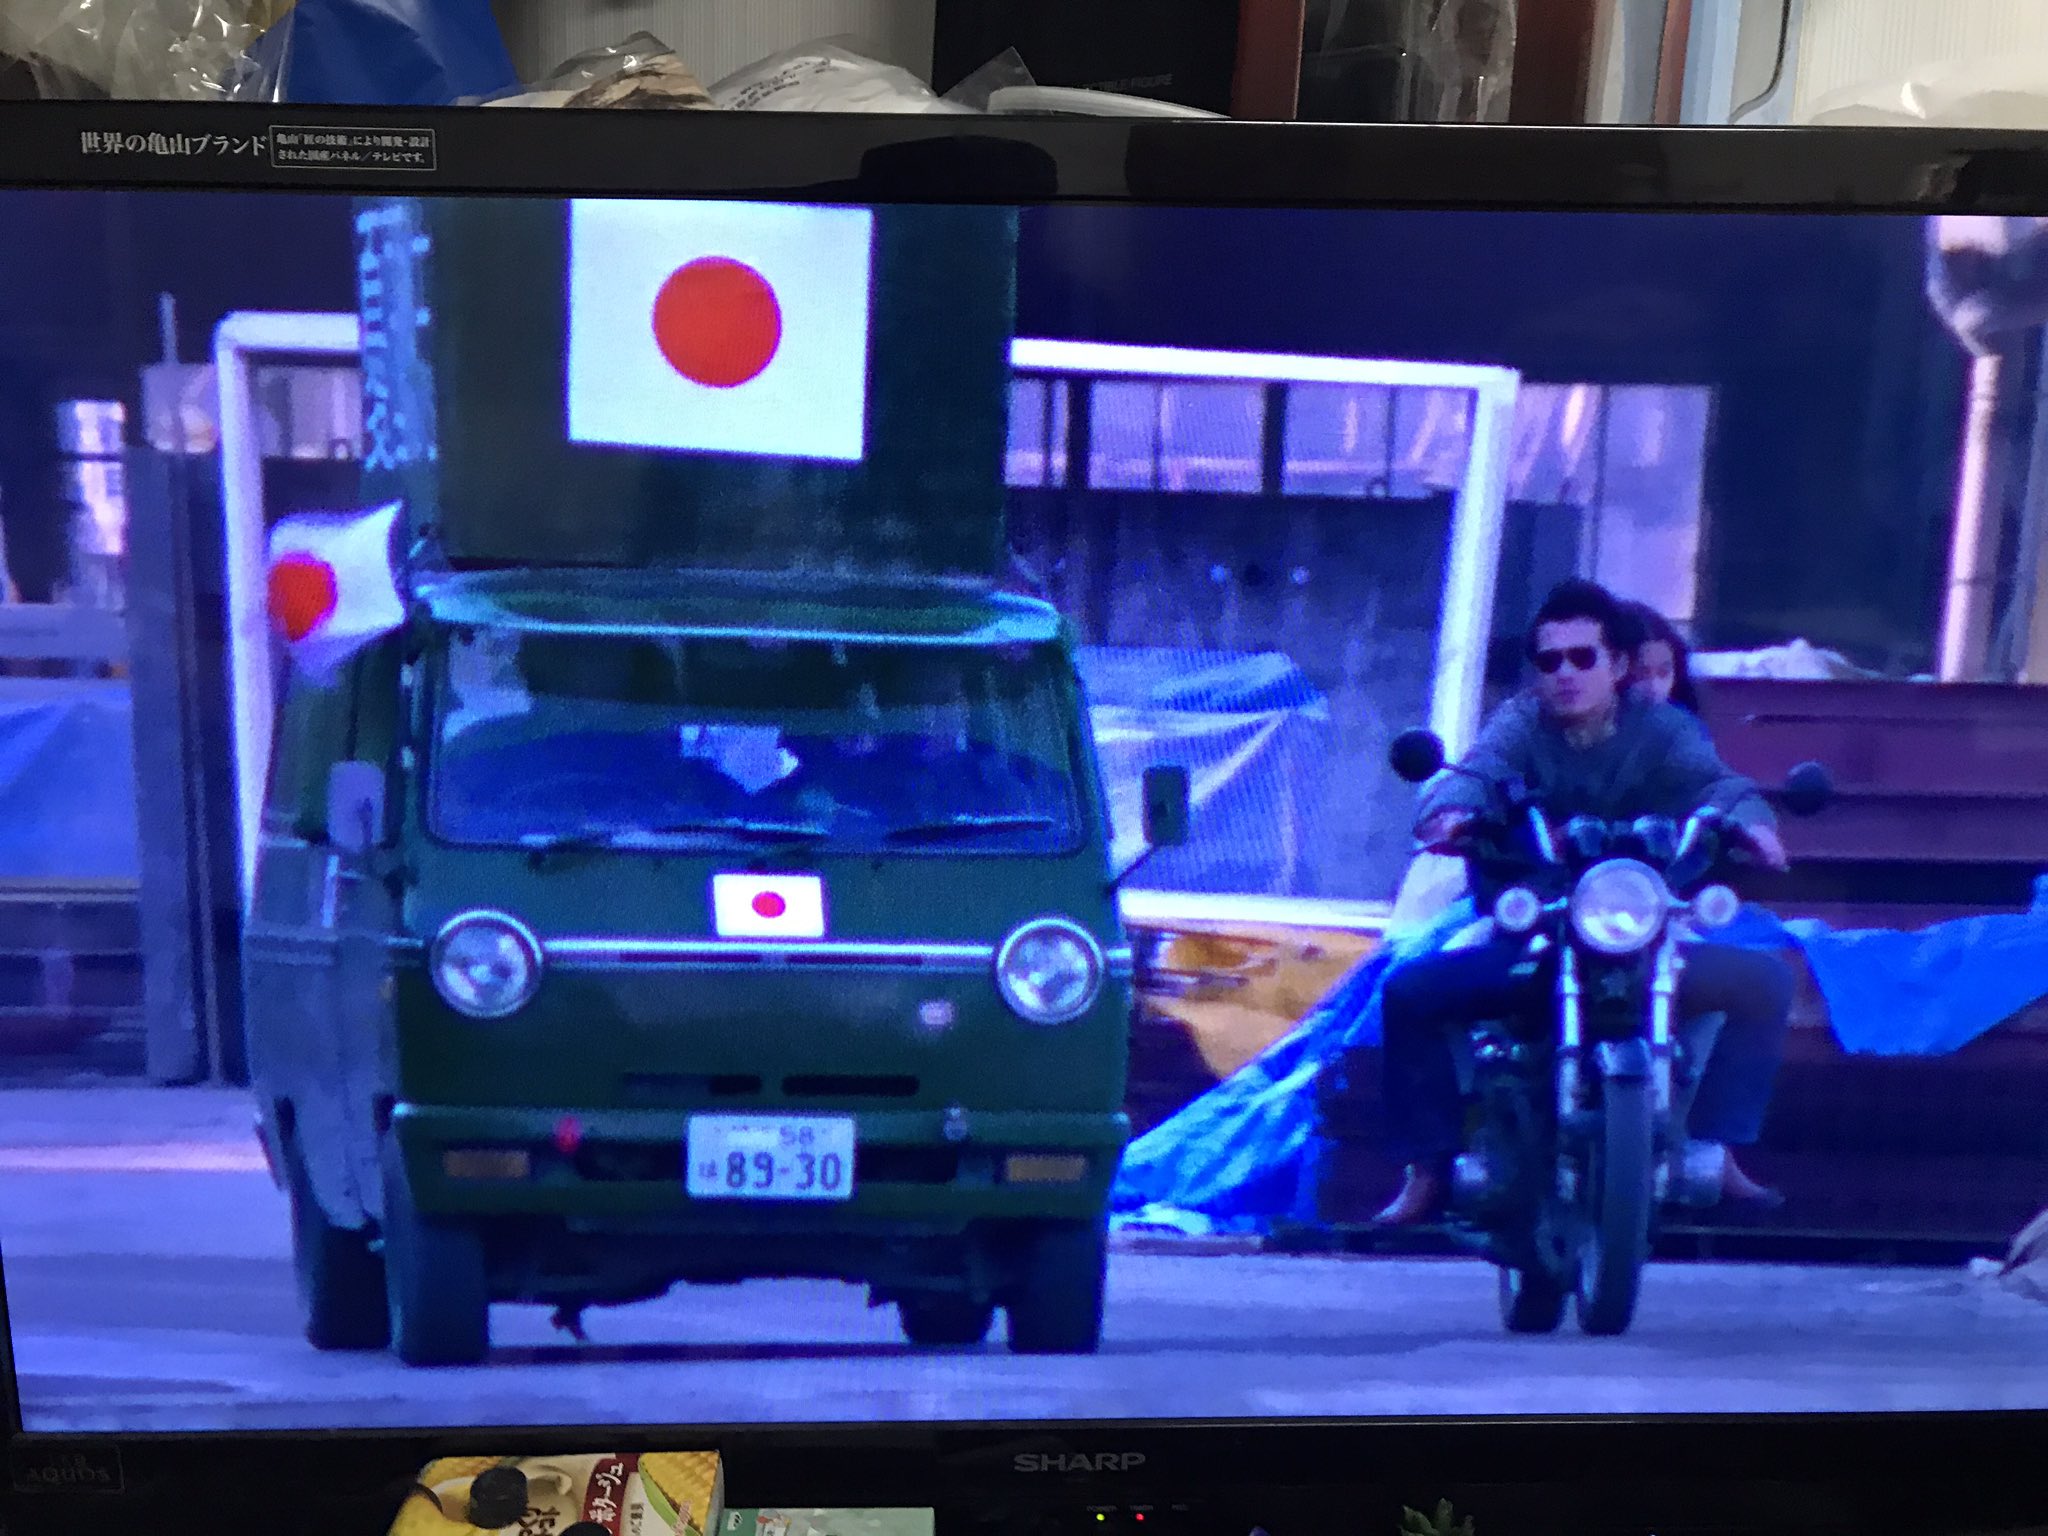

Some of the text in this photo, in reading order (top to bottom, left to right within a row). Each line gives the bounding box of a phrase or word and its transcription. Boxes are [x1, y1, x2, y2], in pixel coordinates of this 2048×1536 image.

[80, 131, 267, 156] 世界の亀山ブランド
[726, 1151, 841, 1190] 89-30
[1014, 1453, 1146, 1472] SHARP
